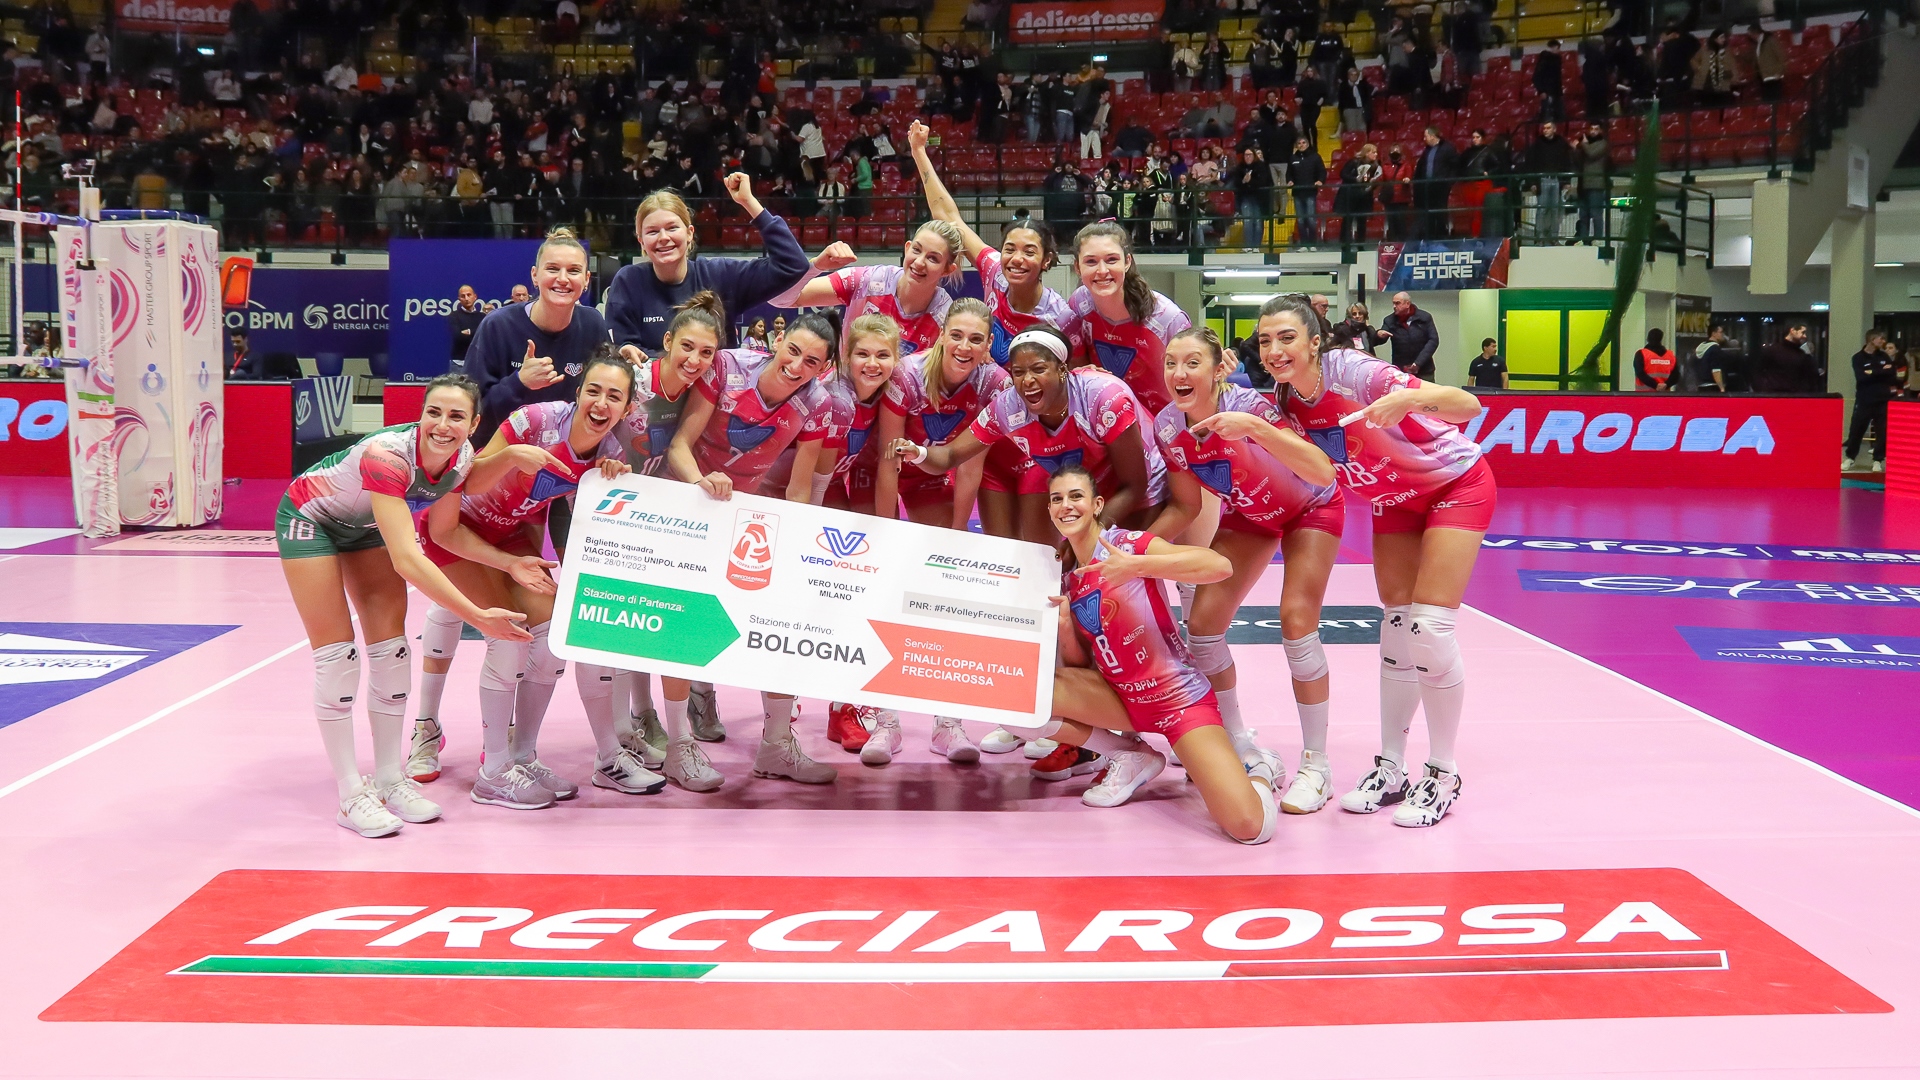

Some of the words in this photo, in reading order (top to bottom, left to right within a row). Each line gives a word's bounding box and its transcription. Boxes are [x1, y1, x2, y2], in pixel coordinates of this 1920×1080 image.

[1017, 10, 1155, 35] delicatesse
[144, 232, 152, 260] SPORT
[1404, 251, 1482, 266] OFFICIAL
[145, 260, 153, 292] GROUP
[1413, 265, 1473, 279] STORE
[145, 292, 154, 326] MASTER
[250, 312, 293, 329] BPM
[1044, 443, 1066, 453] KIPSTA
[855, 468, 870, 489] 15
[1335, 461, 1378, 488] 28
[1394, 488, 1418, 503] BPM
[630, 510, 709, 532] TRENITALIA
[1262, 507, 1285, 521] BPM
[288, 518, 315, 540] 18
[591, 515, 615, 525] GRUPPO
[616, 519, 643, 530] FERROVIE
[644, 524, 662, 533] DELLO
[663, 527, 681, 536] STATO
[681, 530, 707, 540] ITALIANE
[585, 536, 619, 550] Biglietto
[621, 543, 654, 555] squadra
[582, 554, 602, 564] Data:
[604, 557, 647, 571] 28/01/2023
[584, 546, 620, 558] VIAGGIO
[621, 553, 642, 562] verso
[644, 556, 675, 568] UNIPOL
[678, 562, 708, 573] ARENA
[800, 555, 879, 574] VEROVOLLEY
[927, 554, 1021, 575] FRECCIAROSSA
[808, 579, 831, 588] VERO
[833, 582, 866, 593] VOLLEY
[942, 572, 964, 582] TRENO
[966, 576, 1000, 587] UFFICIALE
[583, 587, 625, 602] Stazione
[627, 595, 637, 604] di
[639, 596, 685, 613] Partenza:
[819, 590, 852, 601] MILANO
[577, 603, 663, 632] MILANO
[909, 600, 932, 611] PNR:
[934, 604, 1035, 625] #F4VolleyFrecciarossa
[749, 614, 790, 628] Stazione
[793, 622, 802, 630] di
[804, 624, 834, 636] Arrivo:
[747, 631, 867, 665] BOLOGNA
[904, 638, 945, 652] Servizio:
[1135, 647, 1149, 664] p!
[0, 660, 112, 668] UARDA
[903, 652, 940, 666] FINALI
[943, 657, 984, 671] COPPA
[987, 664, 1024, 677] ITALIA
[1717, 651, 1803, 661] MILANO
[1809, 656, 1913, 667] MODENA
[902, 665, 994, 686] FRECCIAROSSA
[1134, 678, 1158, 692] BPM
[244, 901, 1703, 953] FRECCIAROSSA
